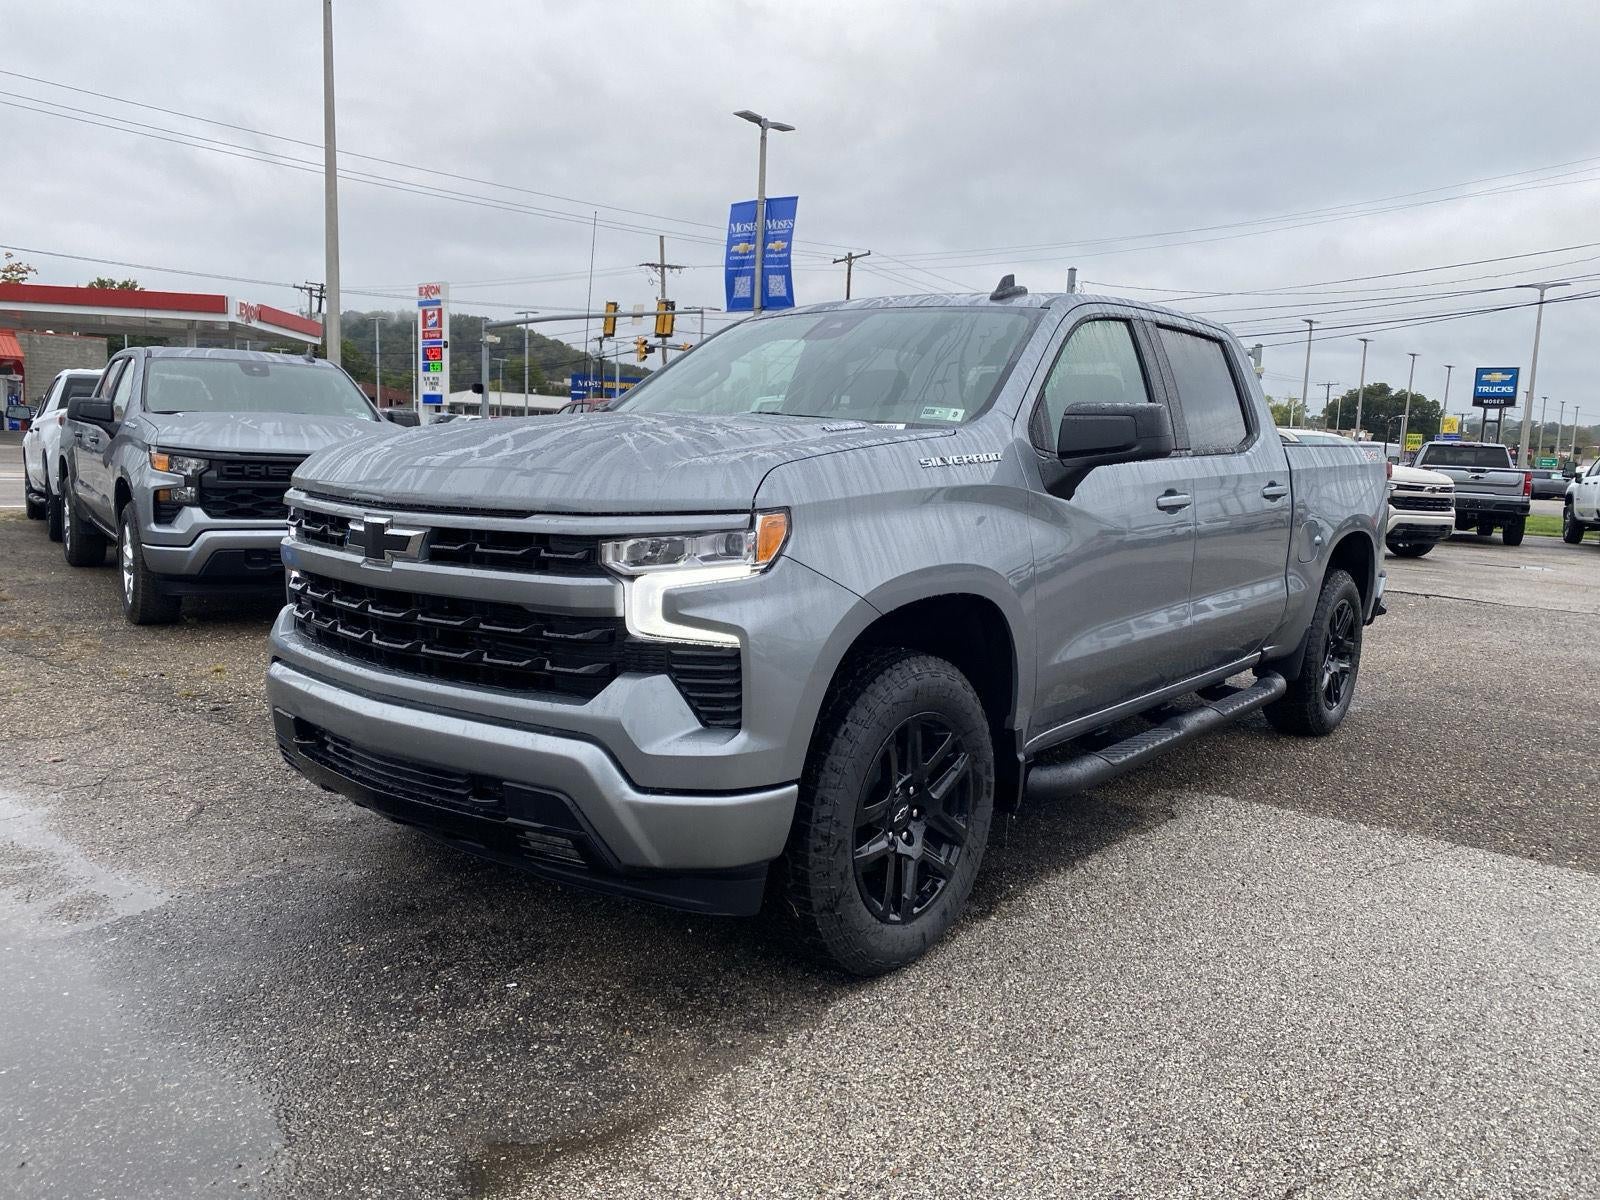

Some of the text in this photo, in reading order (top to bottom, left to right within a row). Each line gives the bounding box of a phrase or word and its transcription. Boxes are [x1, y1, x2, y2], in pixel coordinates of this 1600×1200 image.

[765, 219, 794, 230] MOSES
[418, 284, 441, 299] EXXON
[919, 452, 1002, 468] SILVERADO
